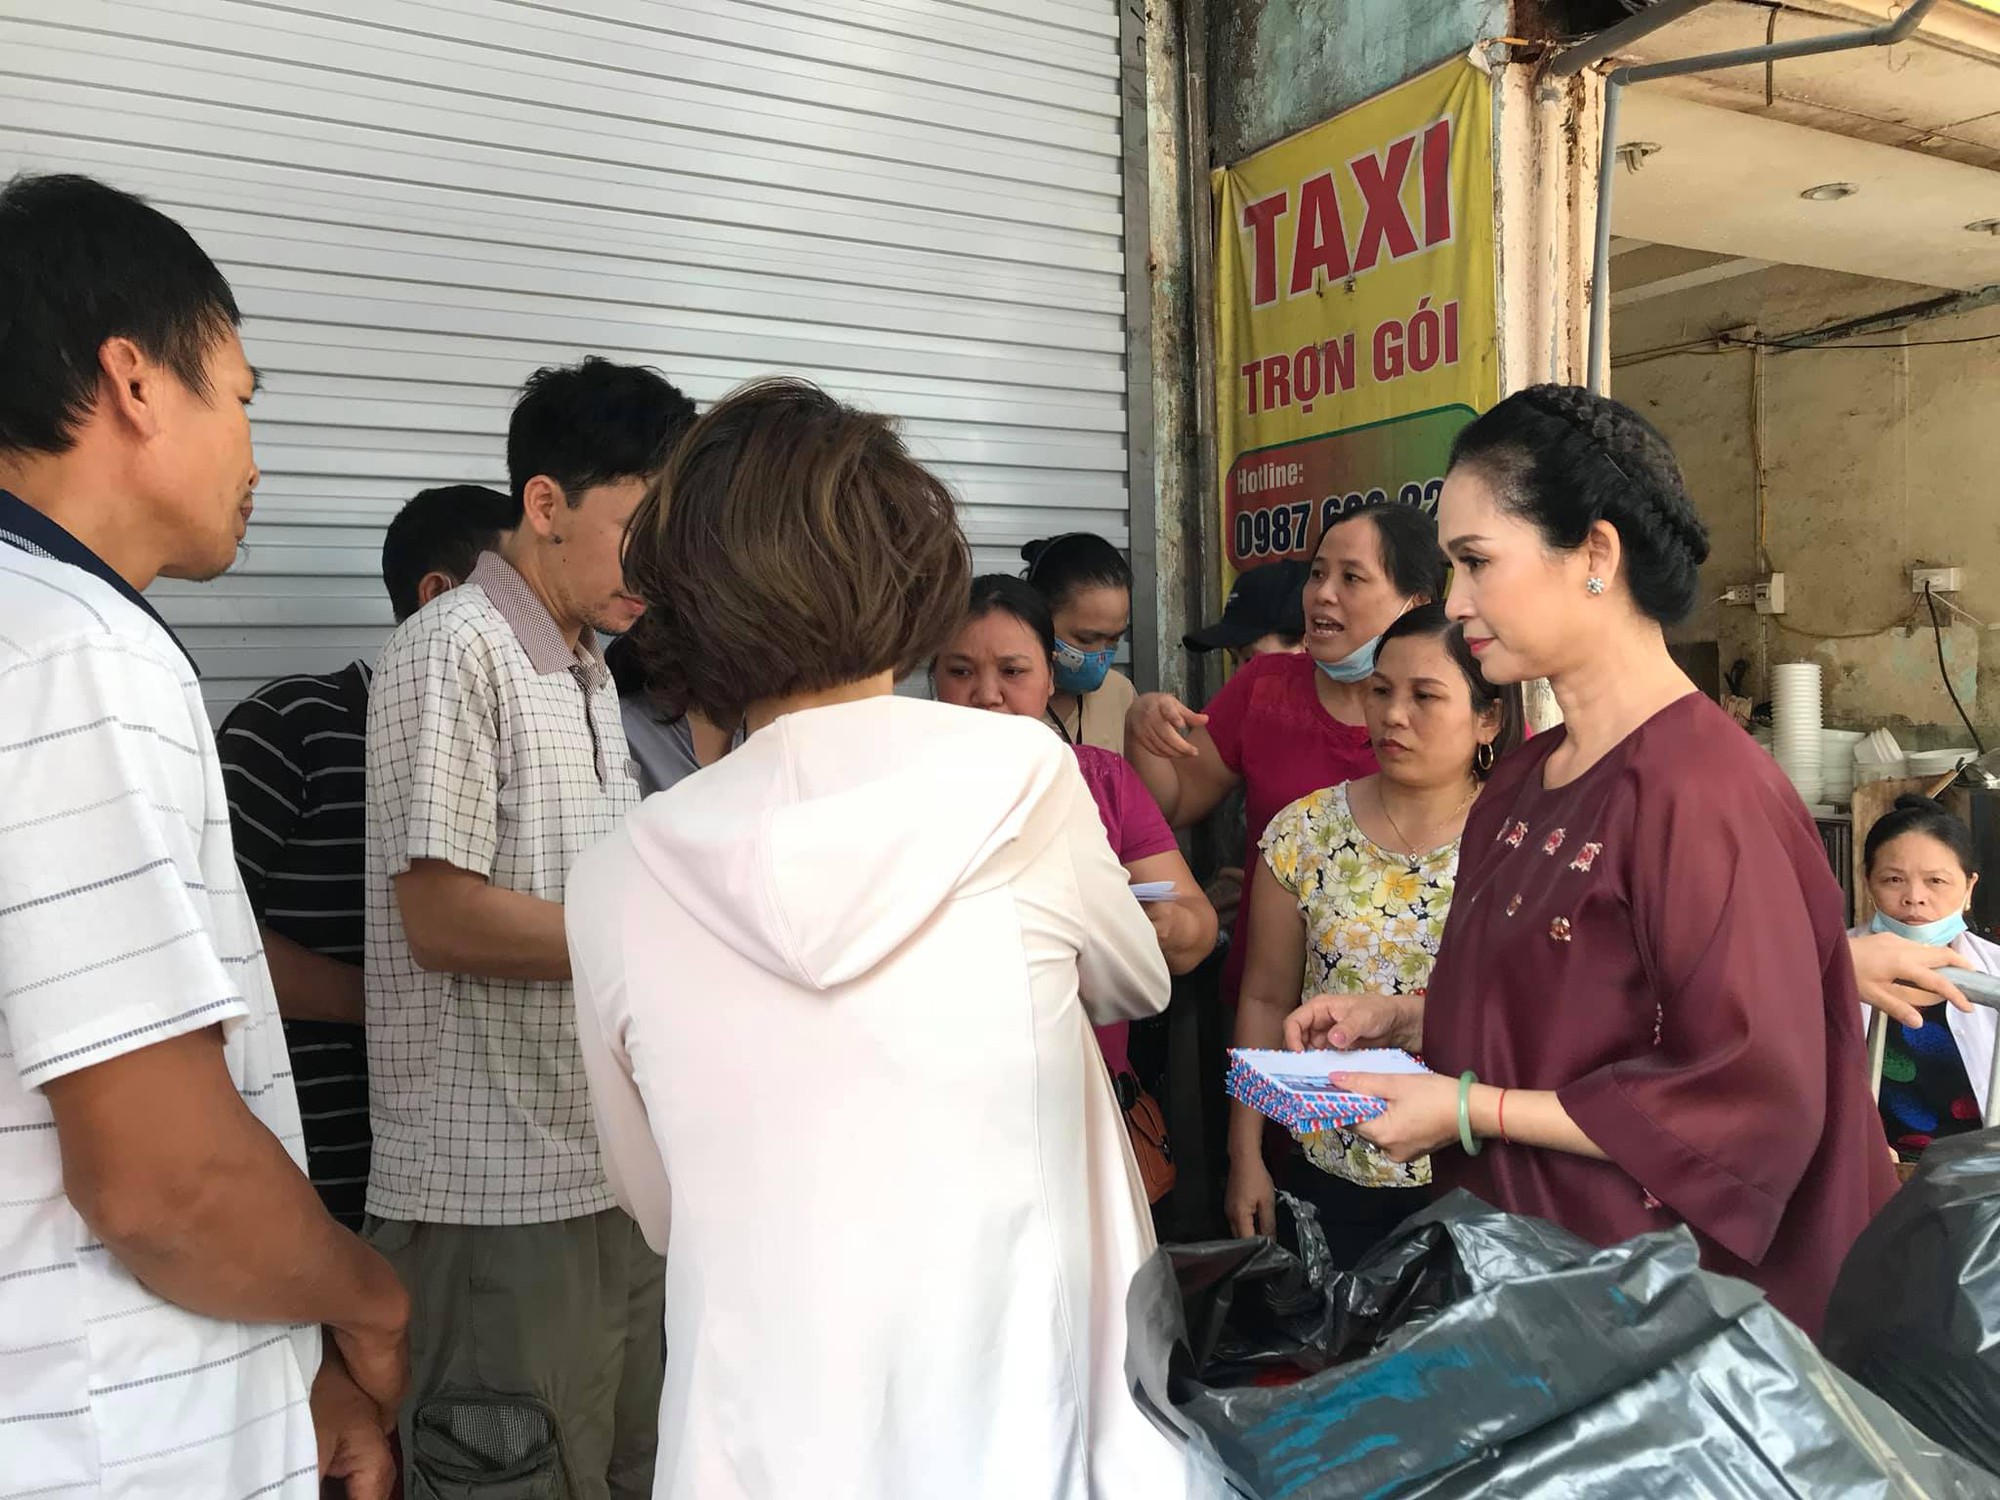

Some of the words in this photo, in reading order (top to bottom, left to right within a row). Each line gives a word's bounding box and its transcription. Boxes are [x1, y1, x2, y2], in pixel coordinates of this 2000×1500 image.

[1242, 117, 1452, 308] TAXI
[1241, 332, 1356, 416] TRỌN
[1372, 296, 1459, 382] GÓI
[1236, 462, 1304, 496] Hotline:
[1235, 500, 1313, 559] 0987
